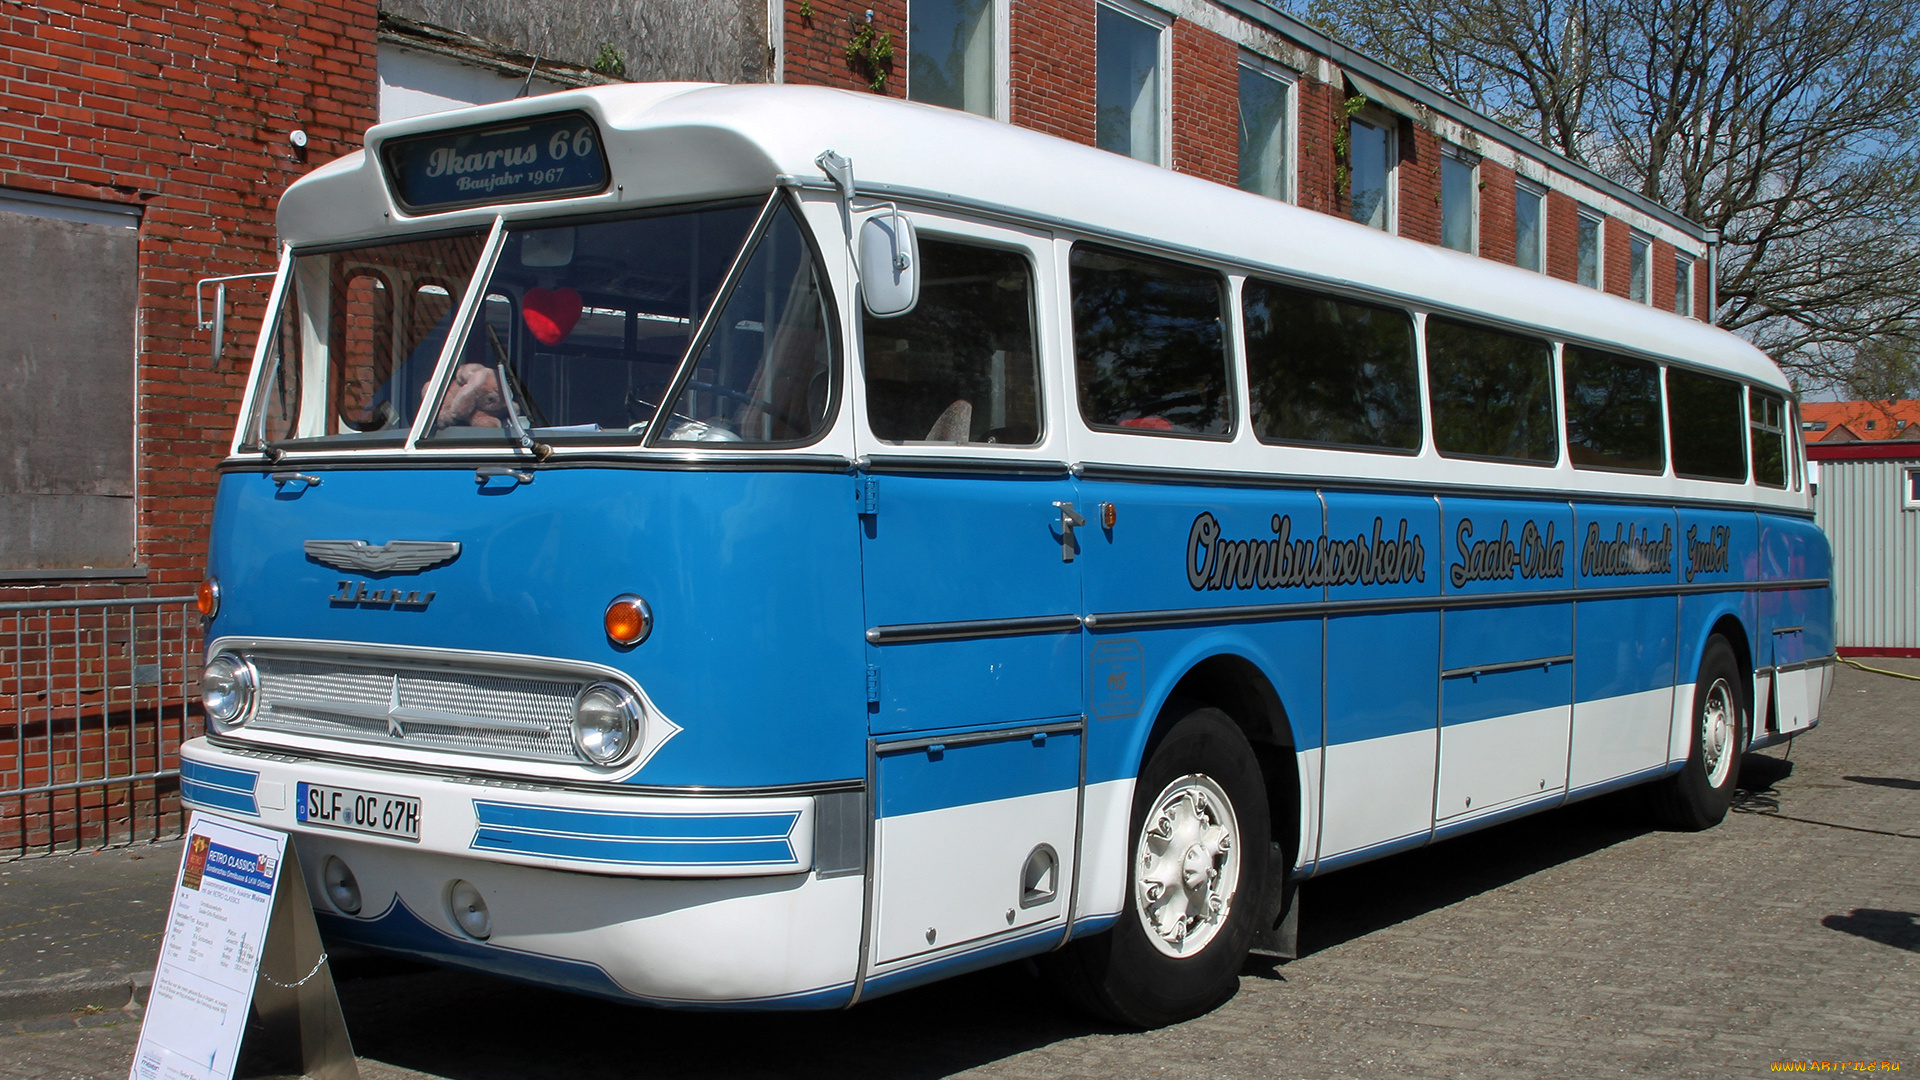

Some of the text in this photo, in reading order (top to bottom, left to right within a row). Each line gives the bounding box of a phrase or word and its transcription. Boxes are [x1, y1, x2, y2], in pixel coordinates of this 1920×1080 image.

[427, 127, 593, 177] Ikarus 66
[457, 167, 565, 191] Baujahr 1967
[1186, 511, 1731, 592] Omnibusverkehr Saale-Orla Rudolstadt GmbH
[309, 788, 420, 834] SLF OC 67H
[208, 850, 228, 866] RETRO
[227, 855, 257, 873] CLASSICS
